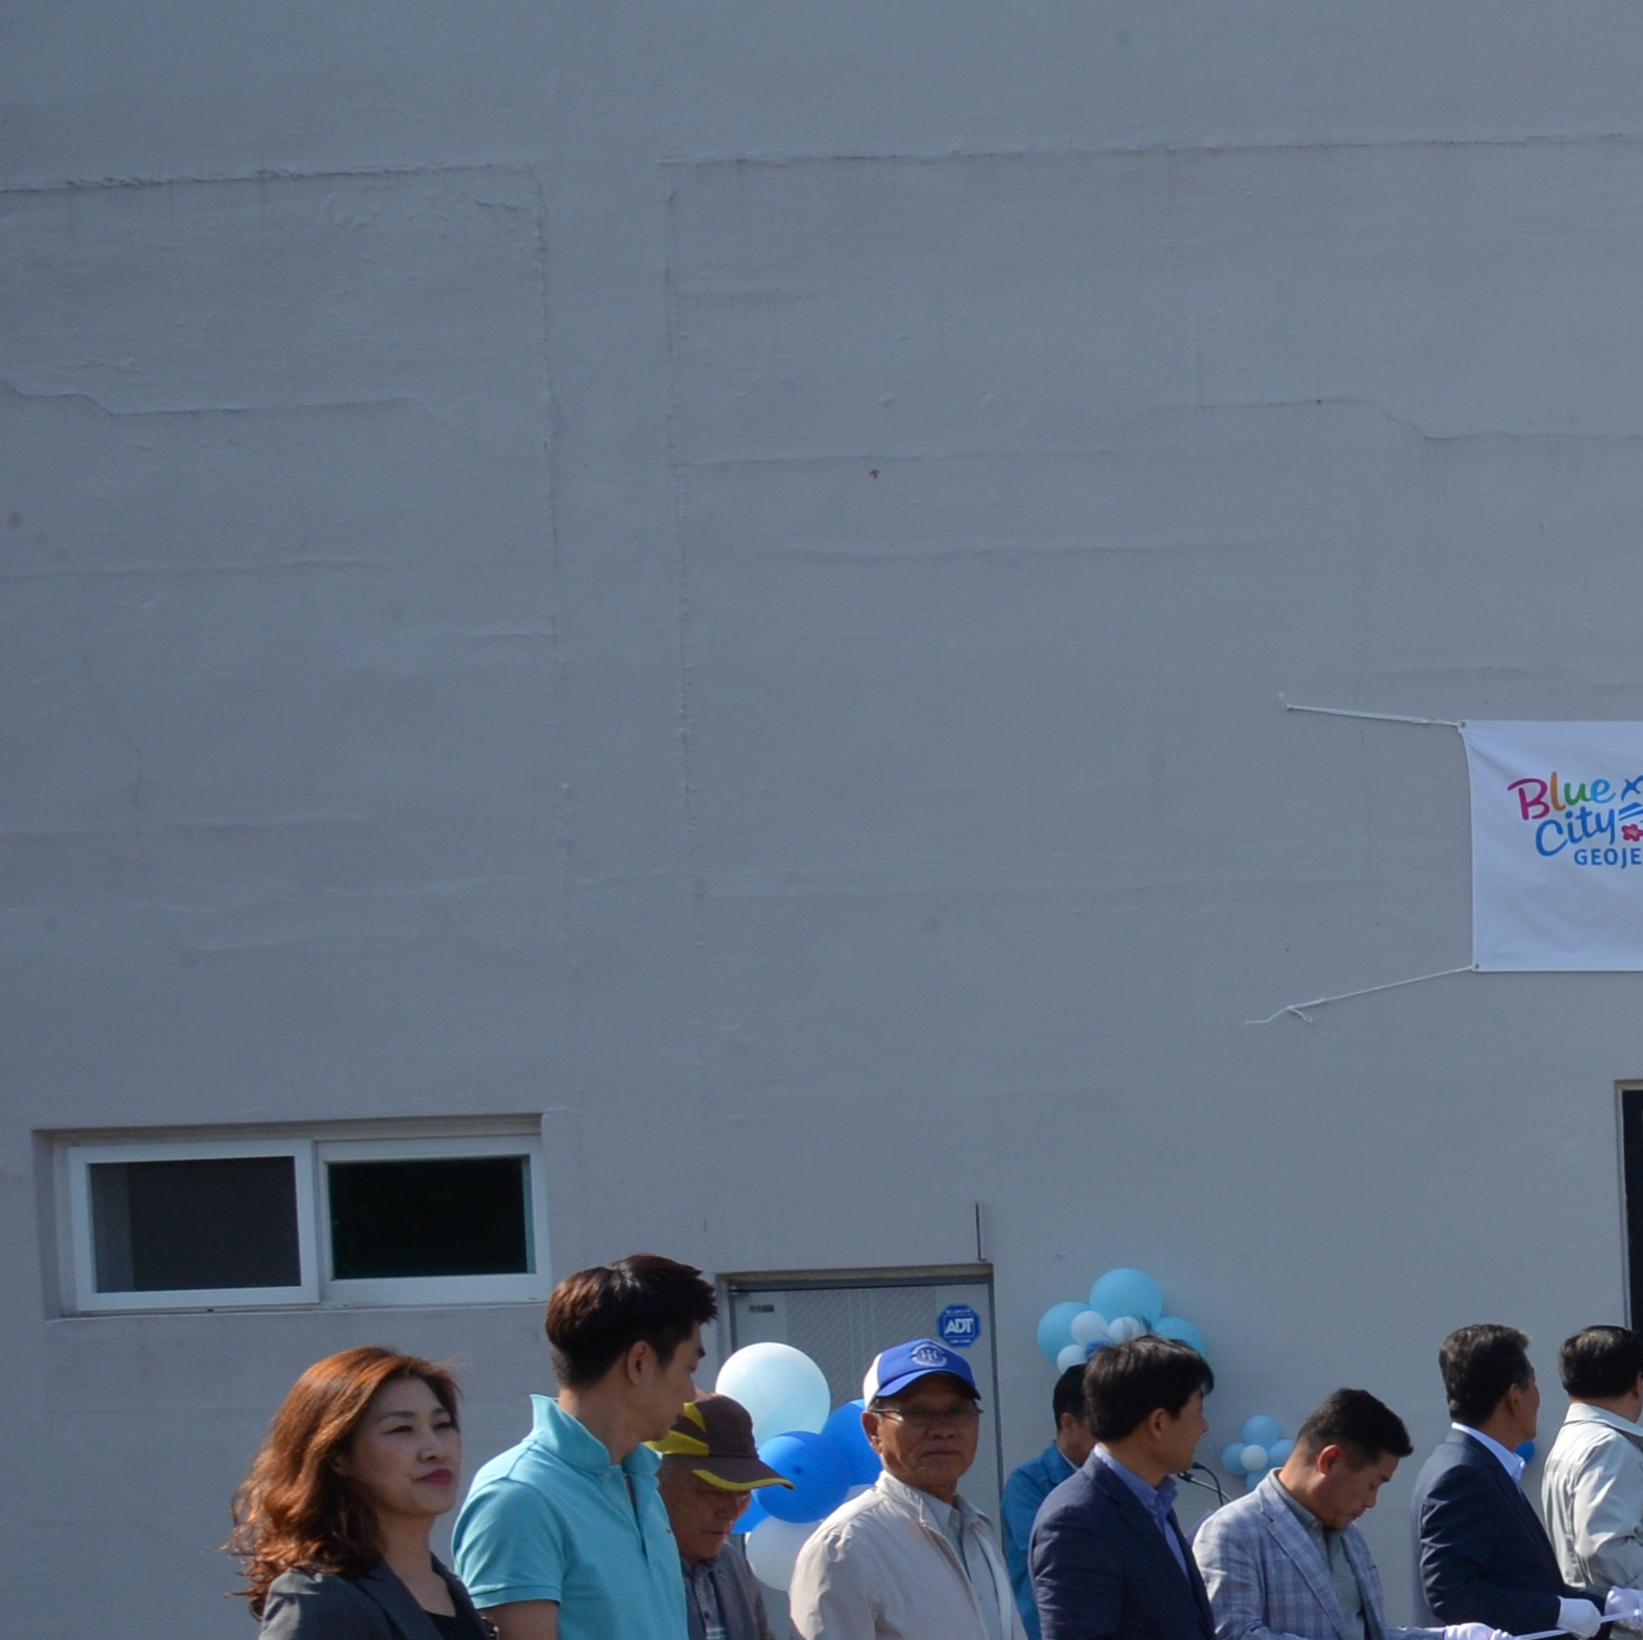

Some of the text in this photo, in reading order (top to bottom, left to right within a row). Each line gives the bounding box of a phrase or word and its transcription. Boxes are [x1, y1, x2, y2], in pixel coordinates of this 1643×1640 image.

[1506, 771, 1617, 821] Blue
[1535, 806, 1616, 857] City
[1573, 847, 1643, 869] GEOJE
[944, 1317, 974, 1335] ADT
